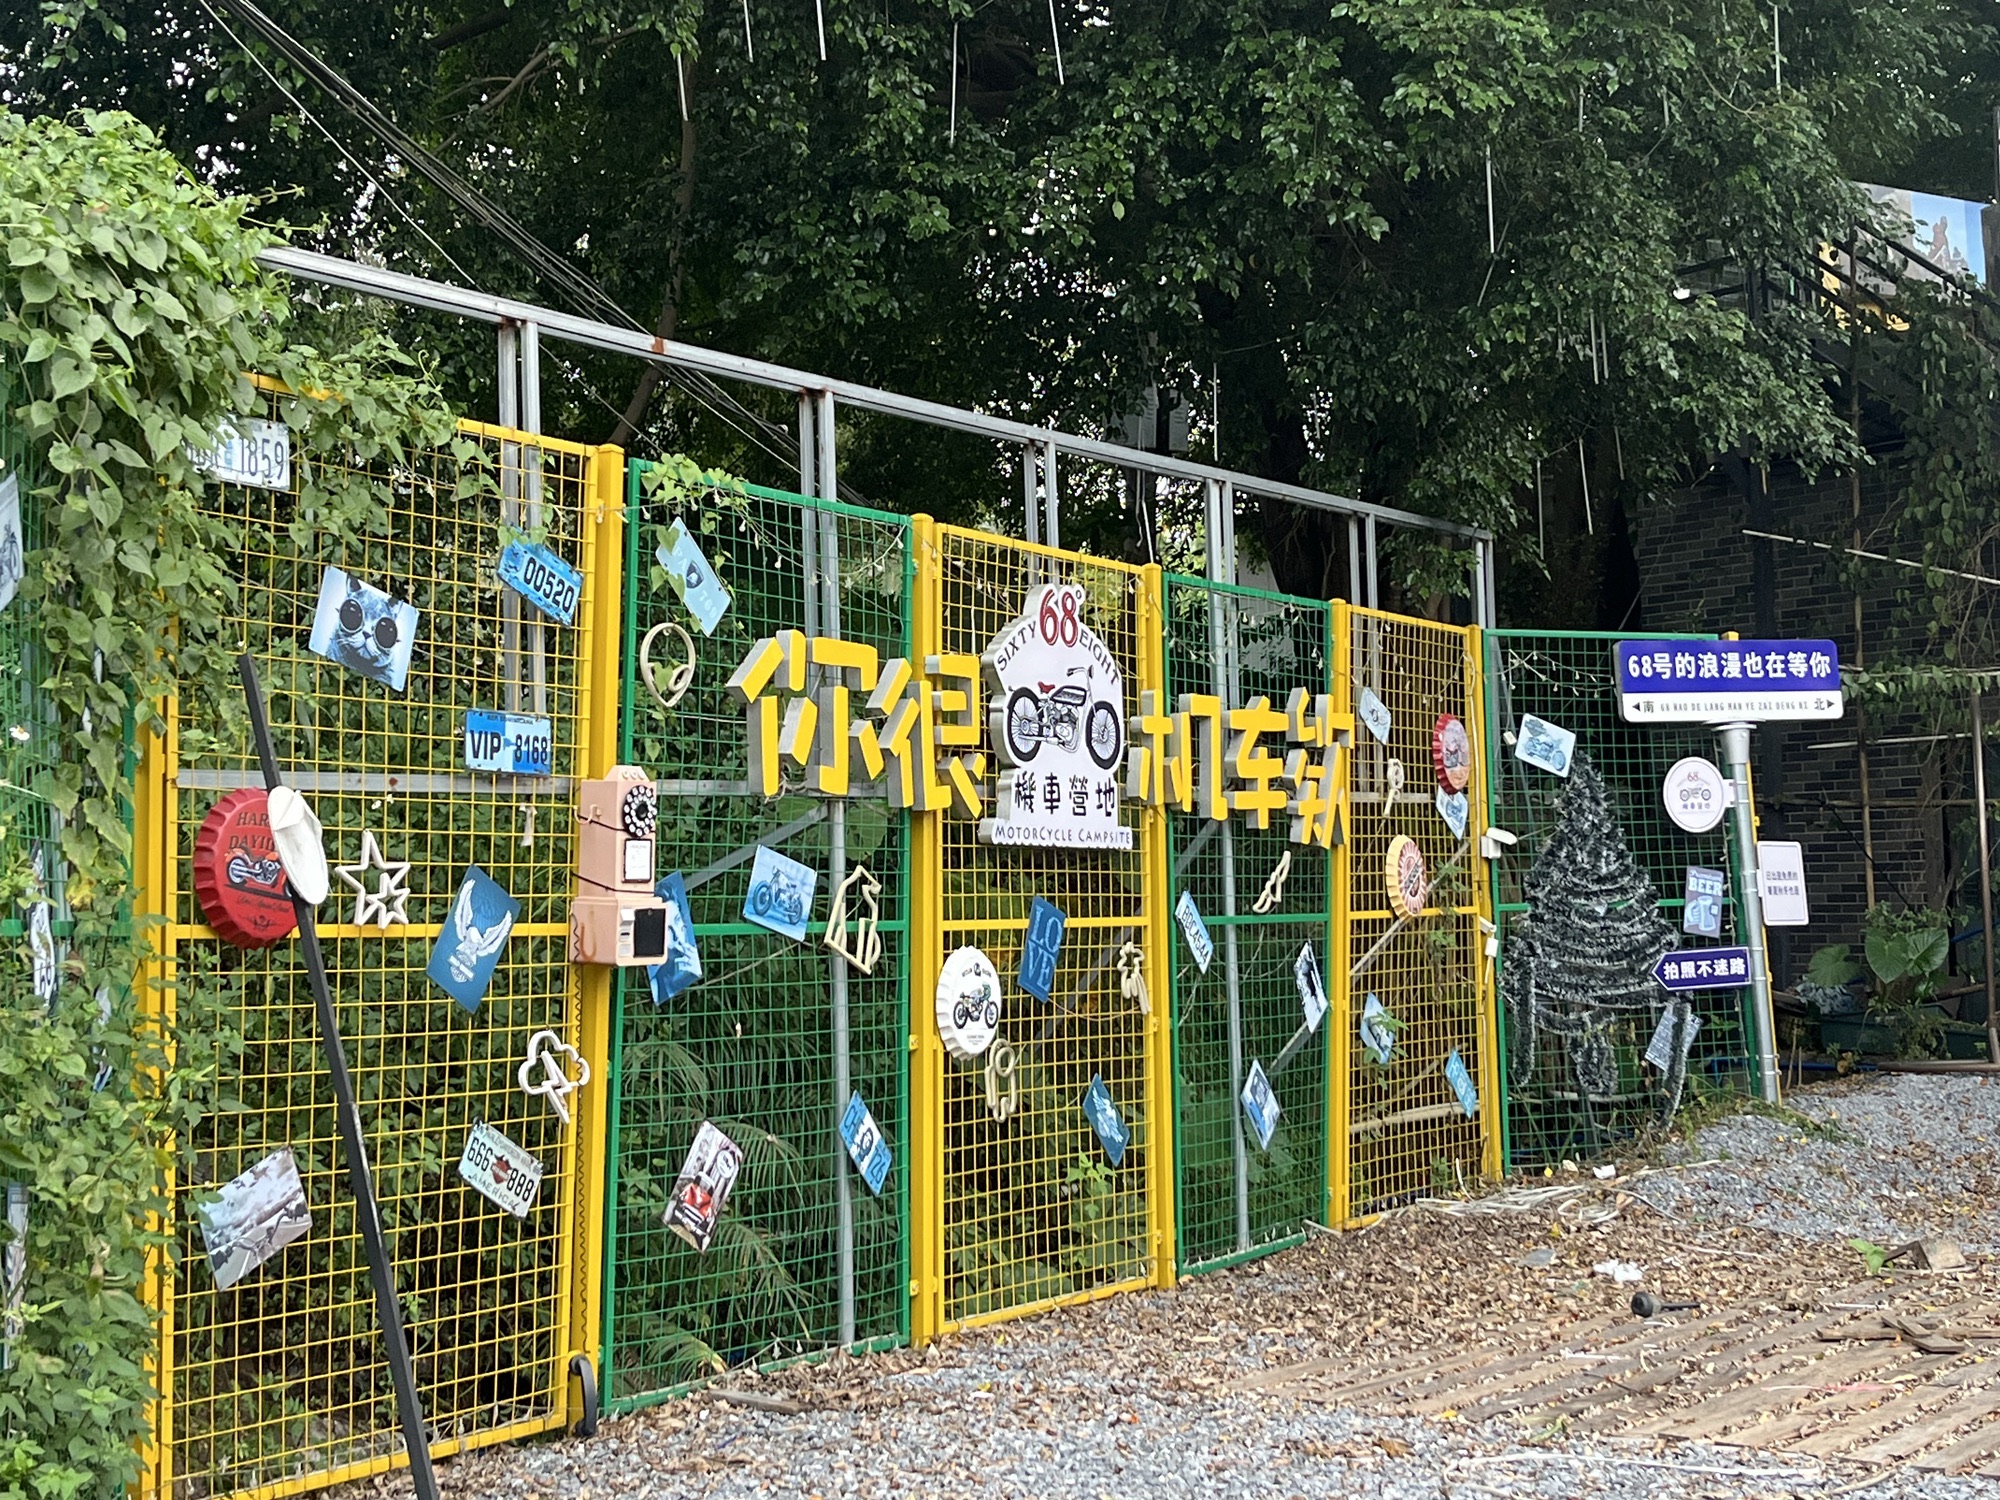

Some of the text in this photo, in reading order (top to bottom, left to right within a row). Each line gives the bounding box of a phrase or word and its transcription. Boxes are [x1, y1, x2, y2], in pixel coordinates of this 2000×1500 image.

[239, 436, 285, 480] 1859
[523, 556, 575, 613] 00520
[997, 621, 1037, 672] SIXTY
[1079, 629, 1120, 686] EIGHT
[1628, 651, 1831, 680] 68号的浪漫也在等你
[1642, 699, 1654, 713] 南
[1691, 702, 1701, 711] DE
[1704, 702, 1725, 711] LANG
[1745, 701, 1755, 711] YE
[1814, 697, 1826, 711] 北
[728, 628, 986, 819] 你很
[470, 729, 548, 765] VIP 8168
[1015, 770, 1116, 817] 機車營地
[236, 811, 271, 827] HAR
[1688, 876, 1722, 897] BEER
[1663, 957, 1745, 980] 拍照不迷路
[467, 1136, 494, 1172] 666
[506, 1168, 535, 1202] 888
[471, 1173, 517, 1209] AMERICA
